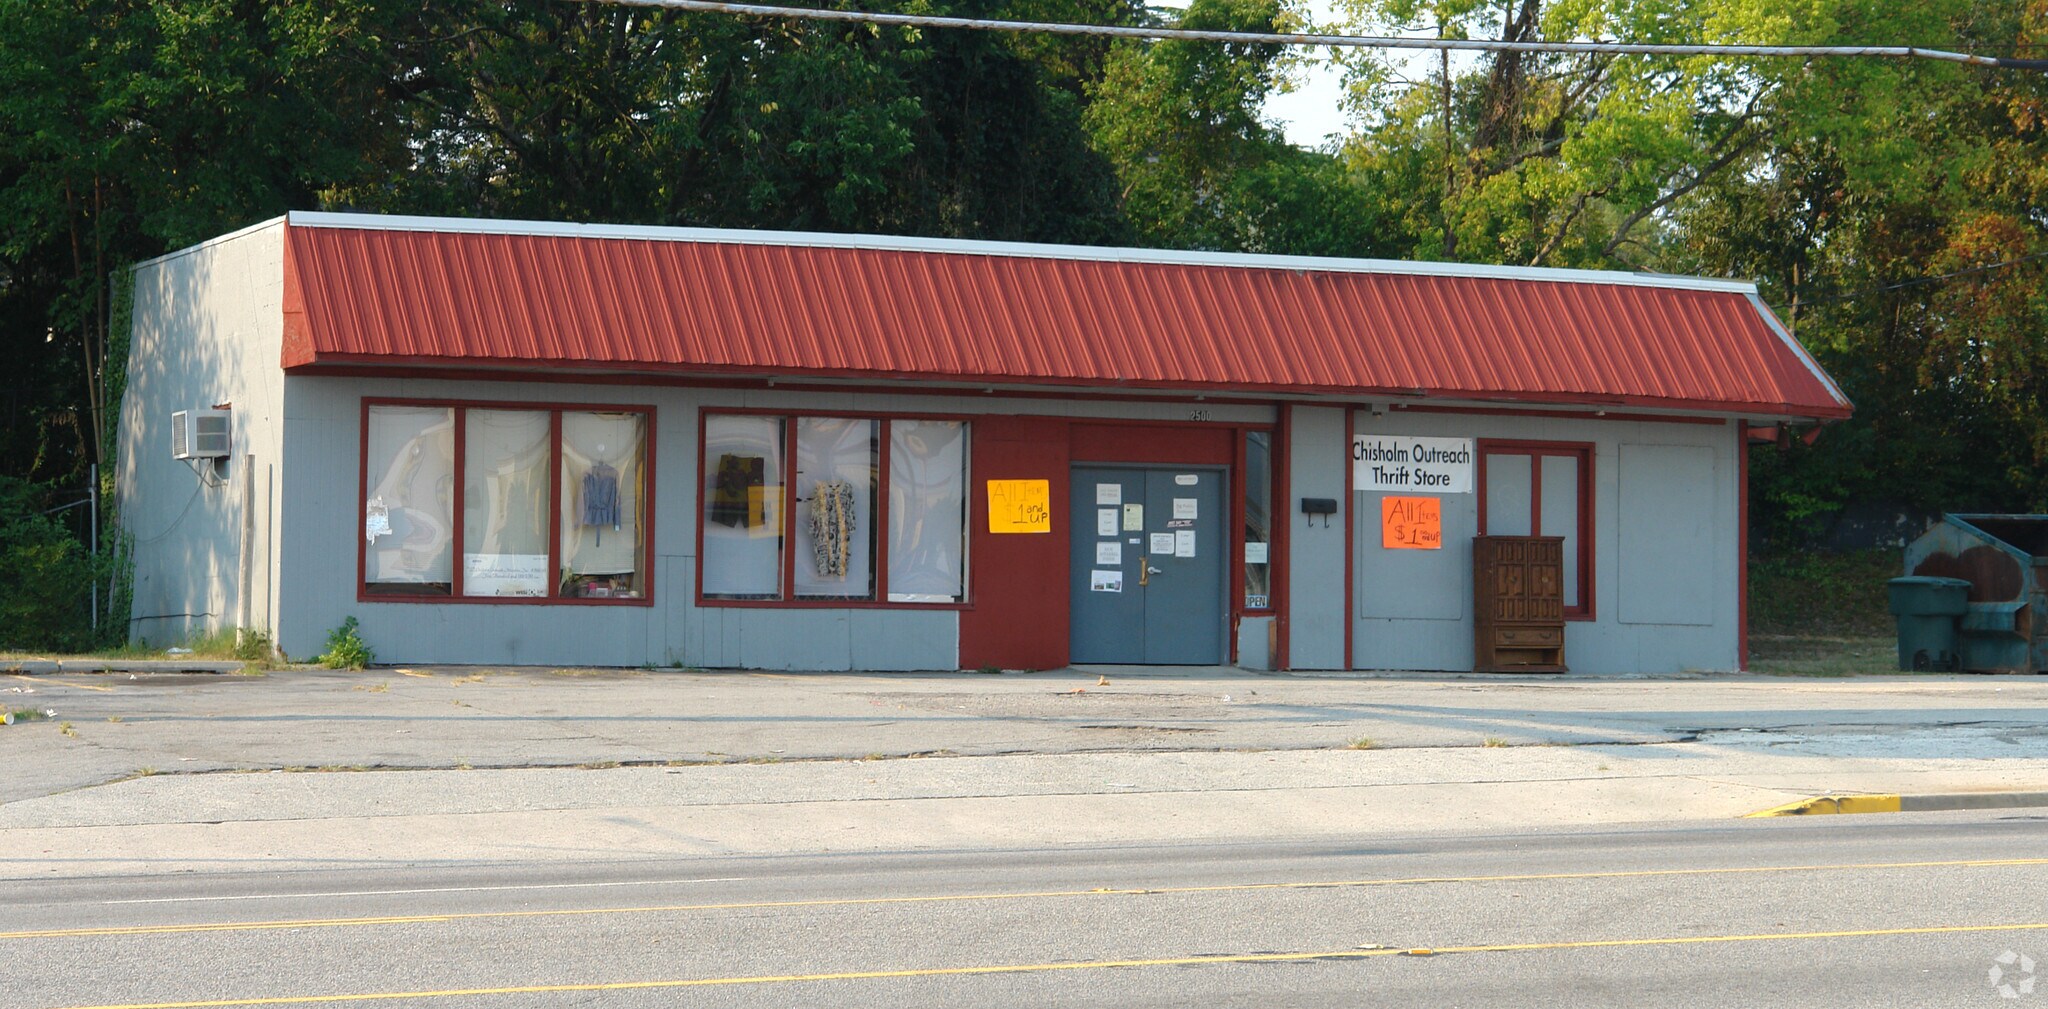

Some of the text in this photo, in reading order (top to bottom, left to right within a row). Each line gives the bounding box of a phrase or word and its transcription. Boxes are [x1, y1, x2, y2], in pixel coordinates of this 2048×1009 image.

[1353, 441, 1470, 464] Chisholm Outreach
[1372, 465, 1450, 486] Thrift Store
[1387, 500, 1414, 525] All
